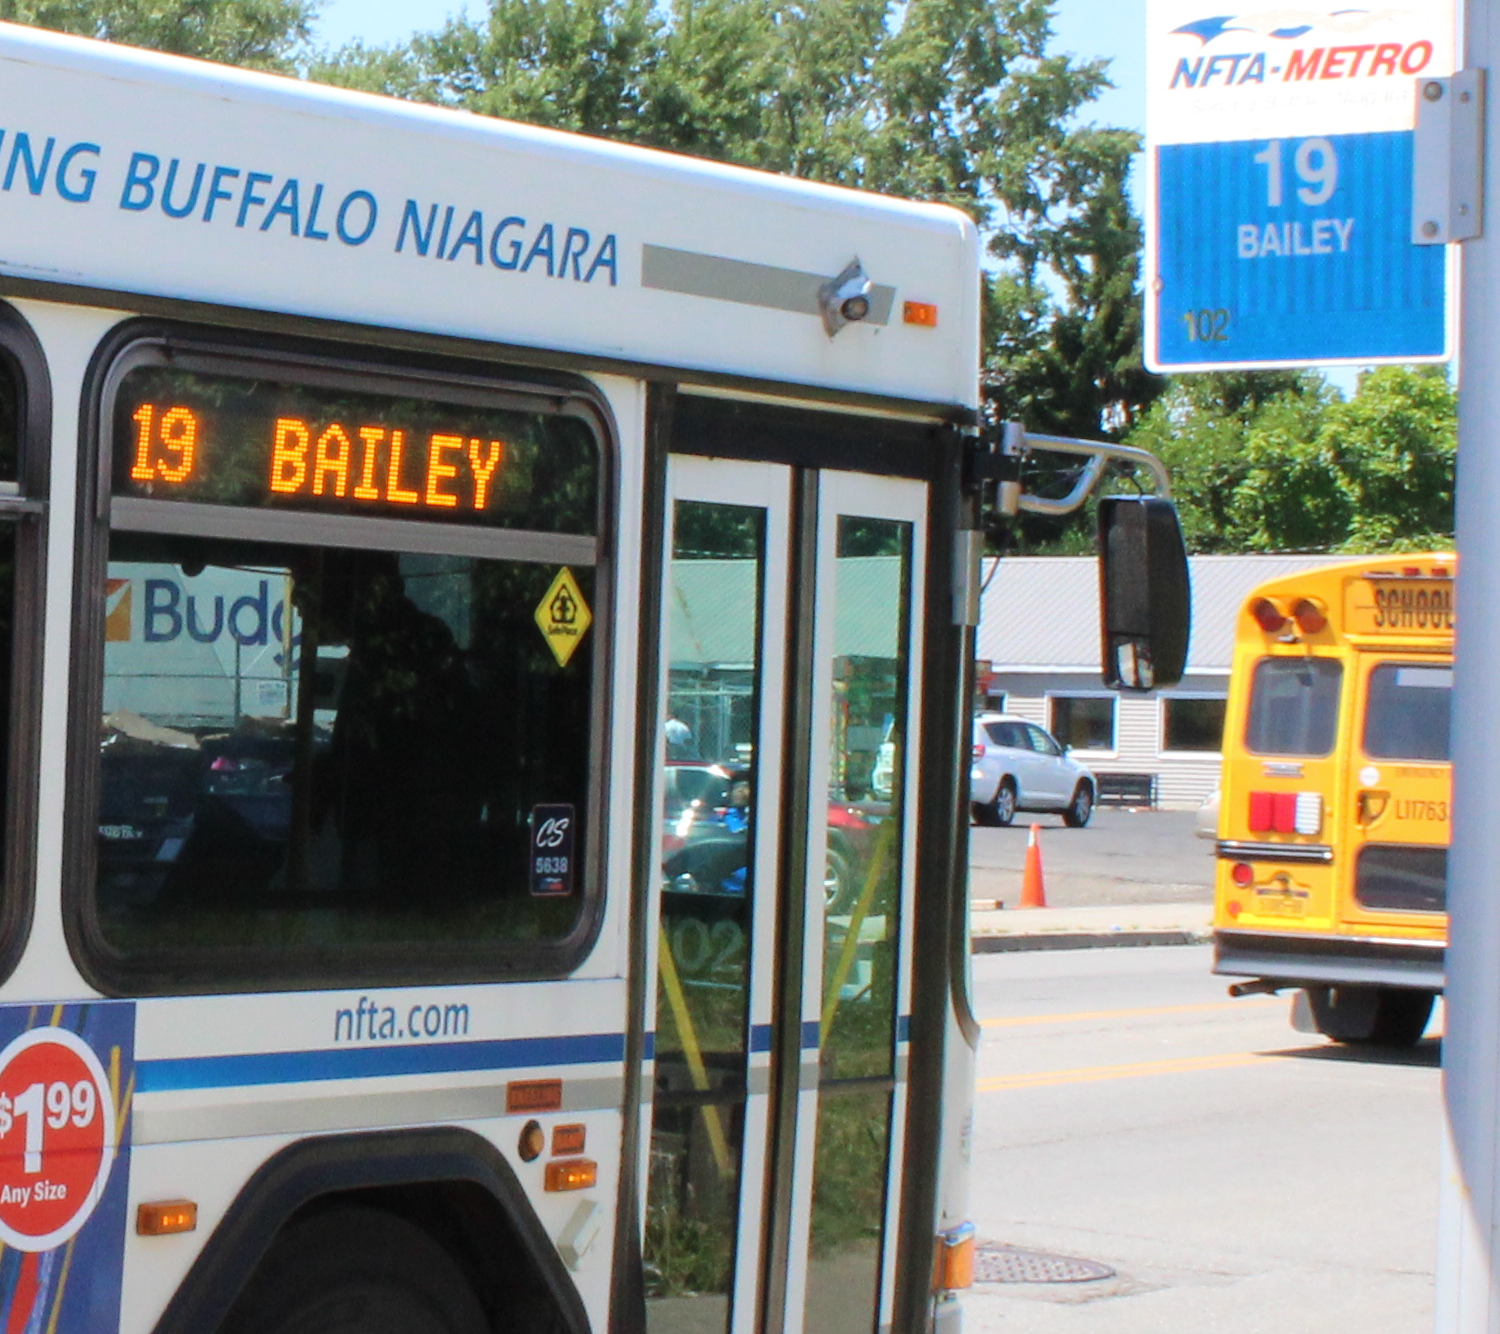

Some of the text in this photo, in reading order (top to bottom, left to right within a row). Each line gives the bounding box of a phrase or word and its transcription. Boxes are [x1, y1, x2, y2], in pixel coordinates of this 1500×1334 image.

[1255, 138, 1338, 207] 19
[120, 152, 378, 245] BUFFALO
[395, 199, 619, 288] NIAGARA
[1238, 218, 1354, 259] BAILEY
[131, 404, 501, 509] 19 BAILEY
[334, 996, 470, 1042] nfta.com
[0, 1180, 67, 1208] Any Size
